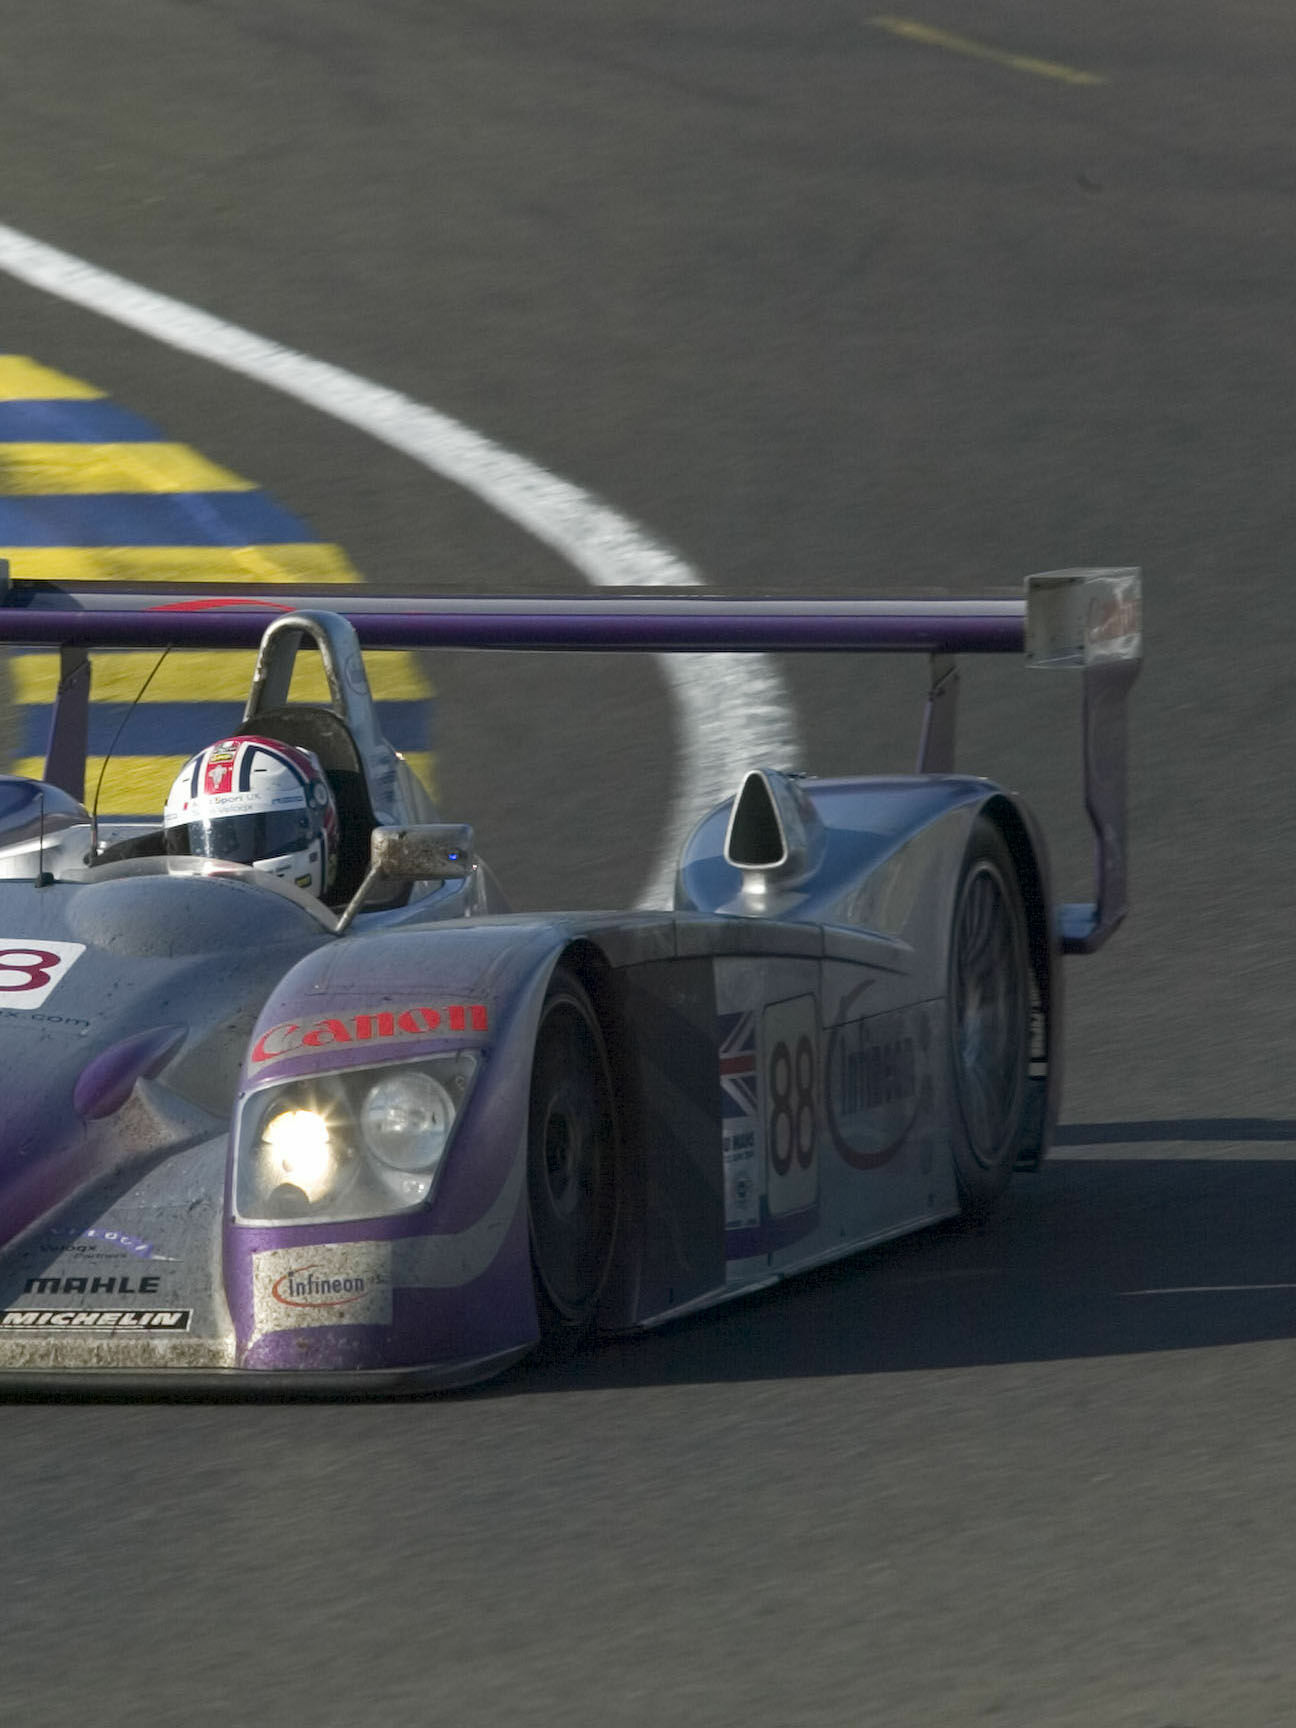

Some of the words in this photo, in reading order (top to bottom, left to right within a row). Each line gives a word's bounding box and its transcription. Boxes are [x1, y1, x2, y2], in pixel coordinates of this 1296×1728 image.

[251, 1004, 488, 1062] Canon
[771, 1034, 816, 1176] 88
[23, 1276, 161, 1294] MAHLE
[2, 1312, 183, 1326] MICHELIN
